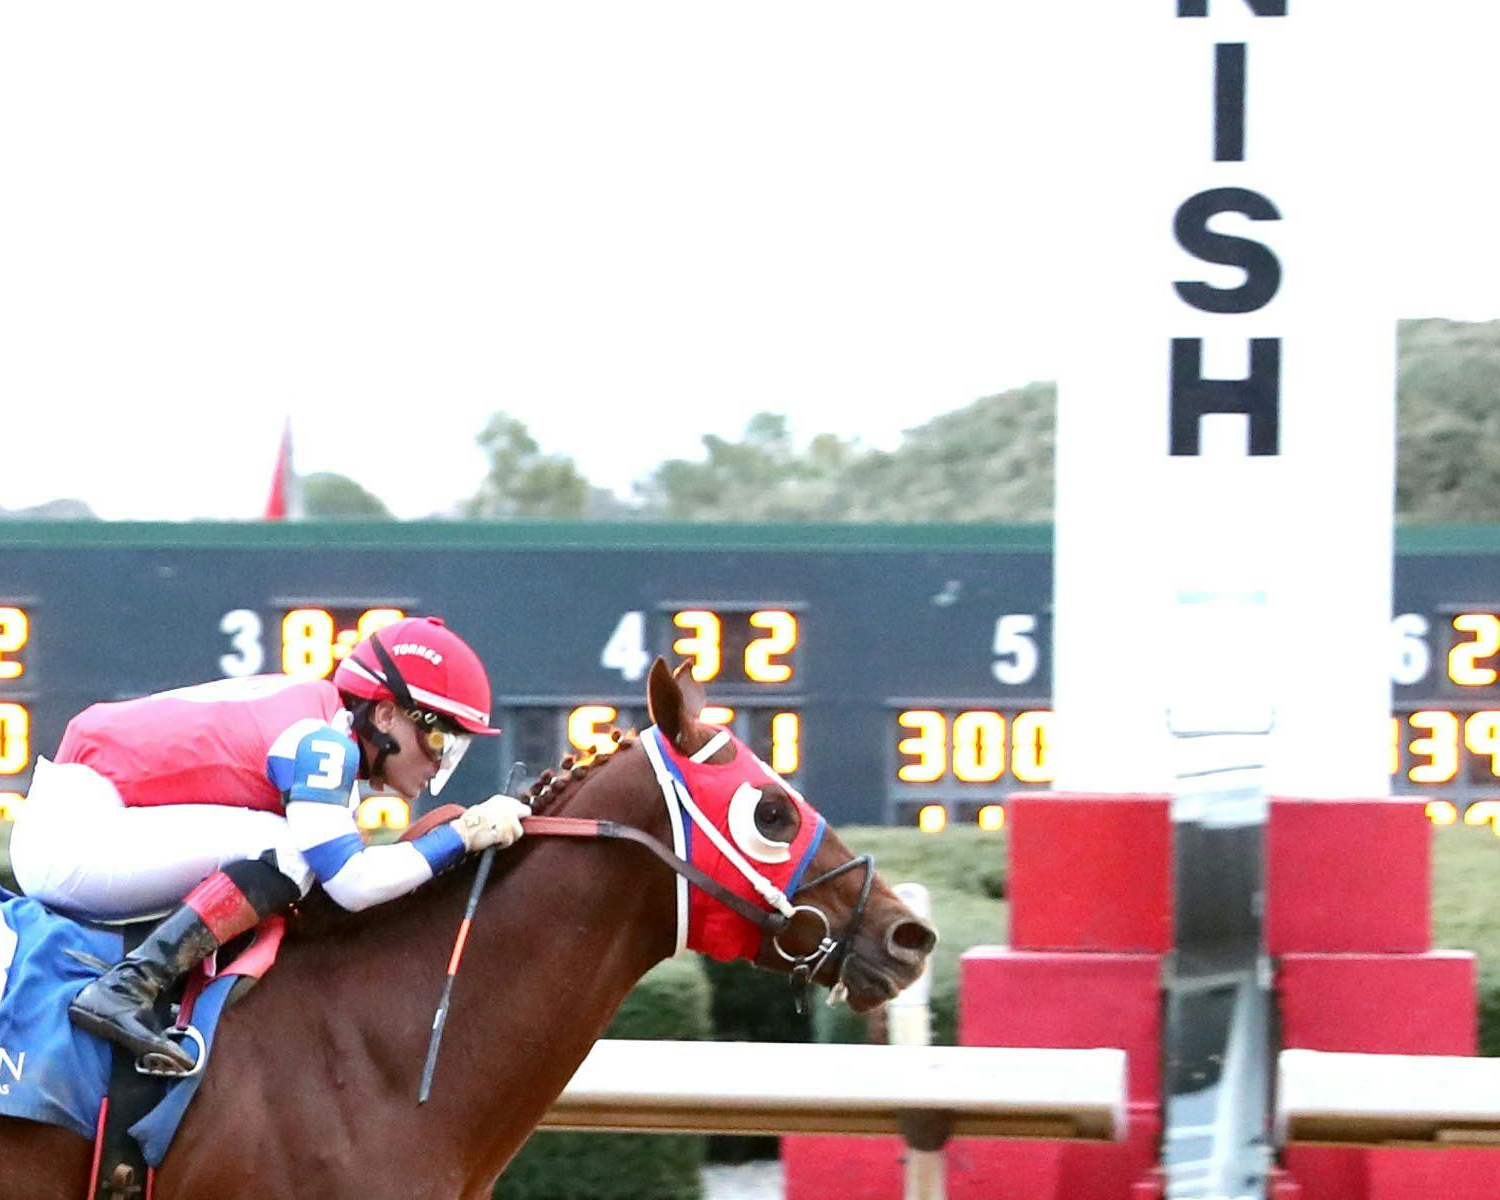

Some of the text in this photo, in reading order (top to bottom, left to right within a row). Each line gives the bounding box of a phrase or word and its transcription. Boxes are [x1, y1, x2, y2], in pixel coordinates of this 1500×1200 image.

[1167, 0, 1289, 456] ISH
[219, 609, 264, 677] 3
[392, 643, 444, 666] TORRES
[600, 611, 650, 681] 4
[991, 614, 1039, 685] 5
[1390, 613, 1431, 685] 6
[307, 740, 346, 789] 3
